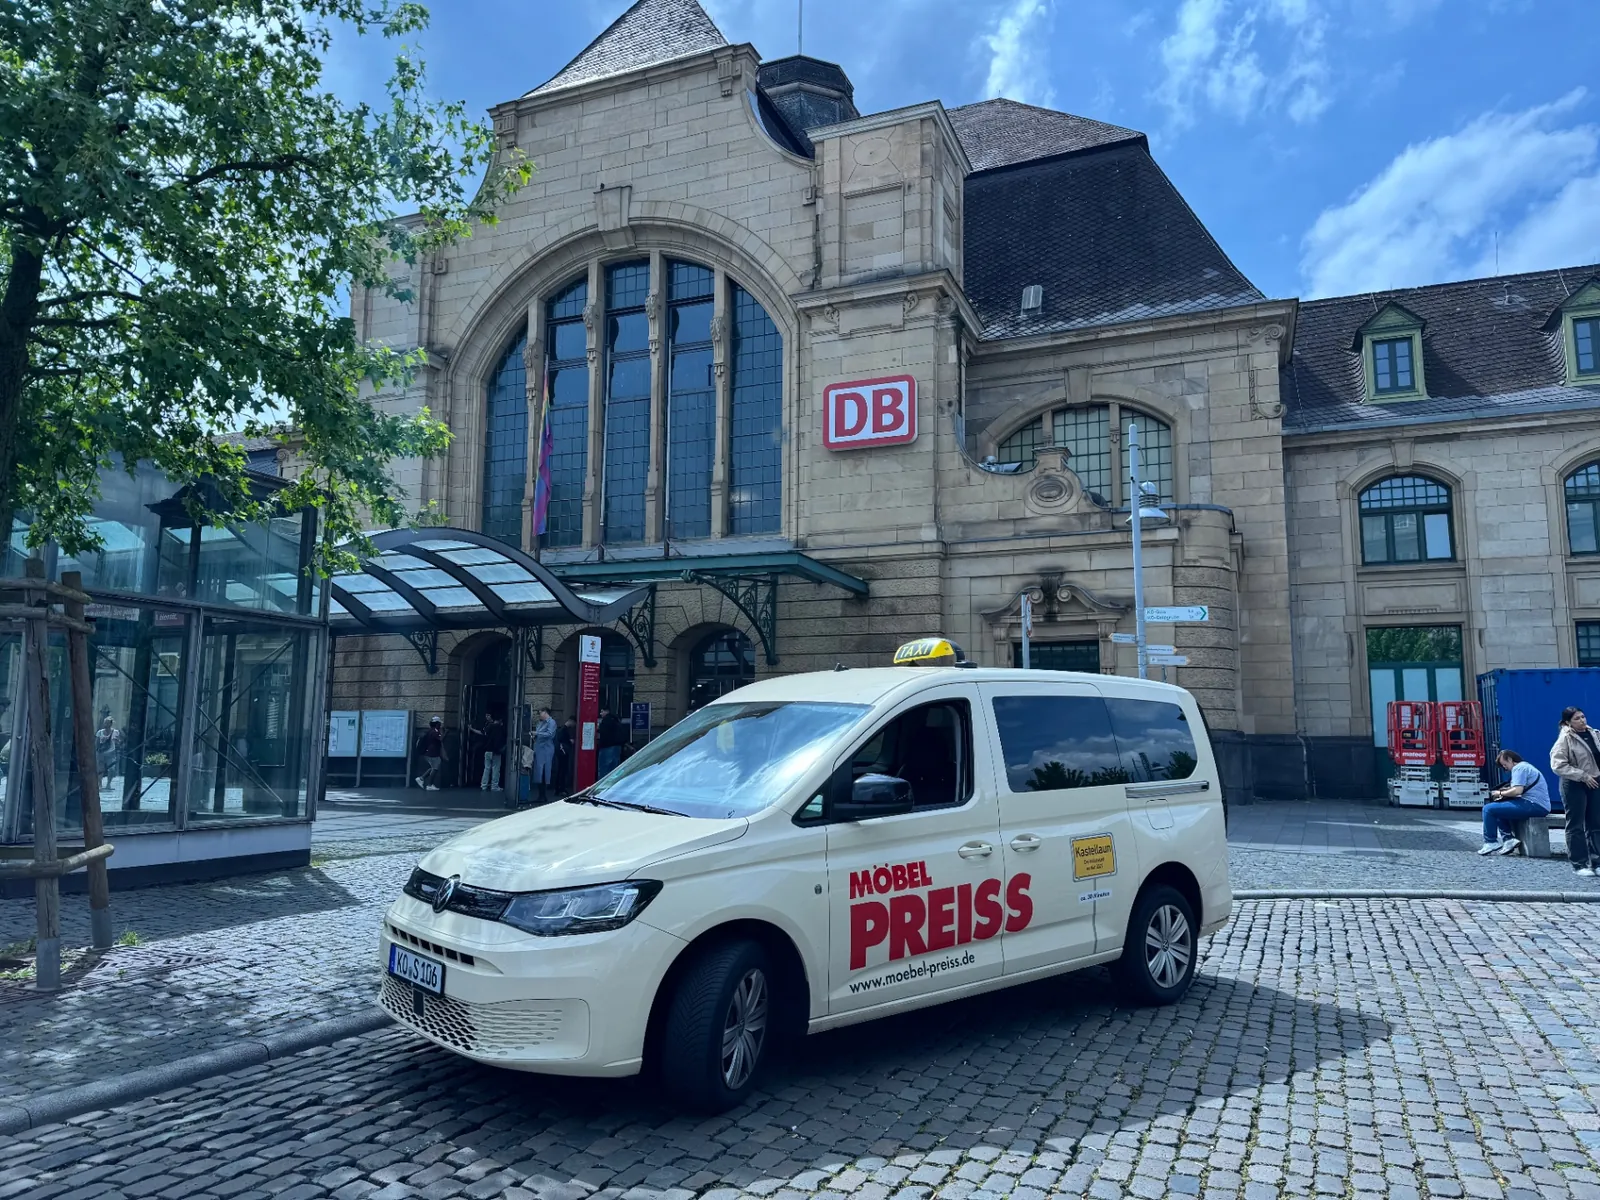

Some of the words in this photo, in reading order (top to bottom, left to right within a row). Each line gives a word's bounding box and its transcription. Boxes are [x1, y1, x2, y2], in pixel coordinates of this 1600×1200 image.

[834, 387, 905, 438] DB
[899, 643, 930, 659] TAXI
[1075, 844, 1112, 858] Kastellaun
[850, 860, 933, 899] MÖBEL
[850, 872, 1034, 971] PREISS
[396, 951, 409, 975] KO
[849, 950, 976, 994] www.moebel-preiss.de
